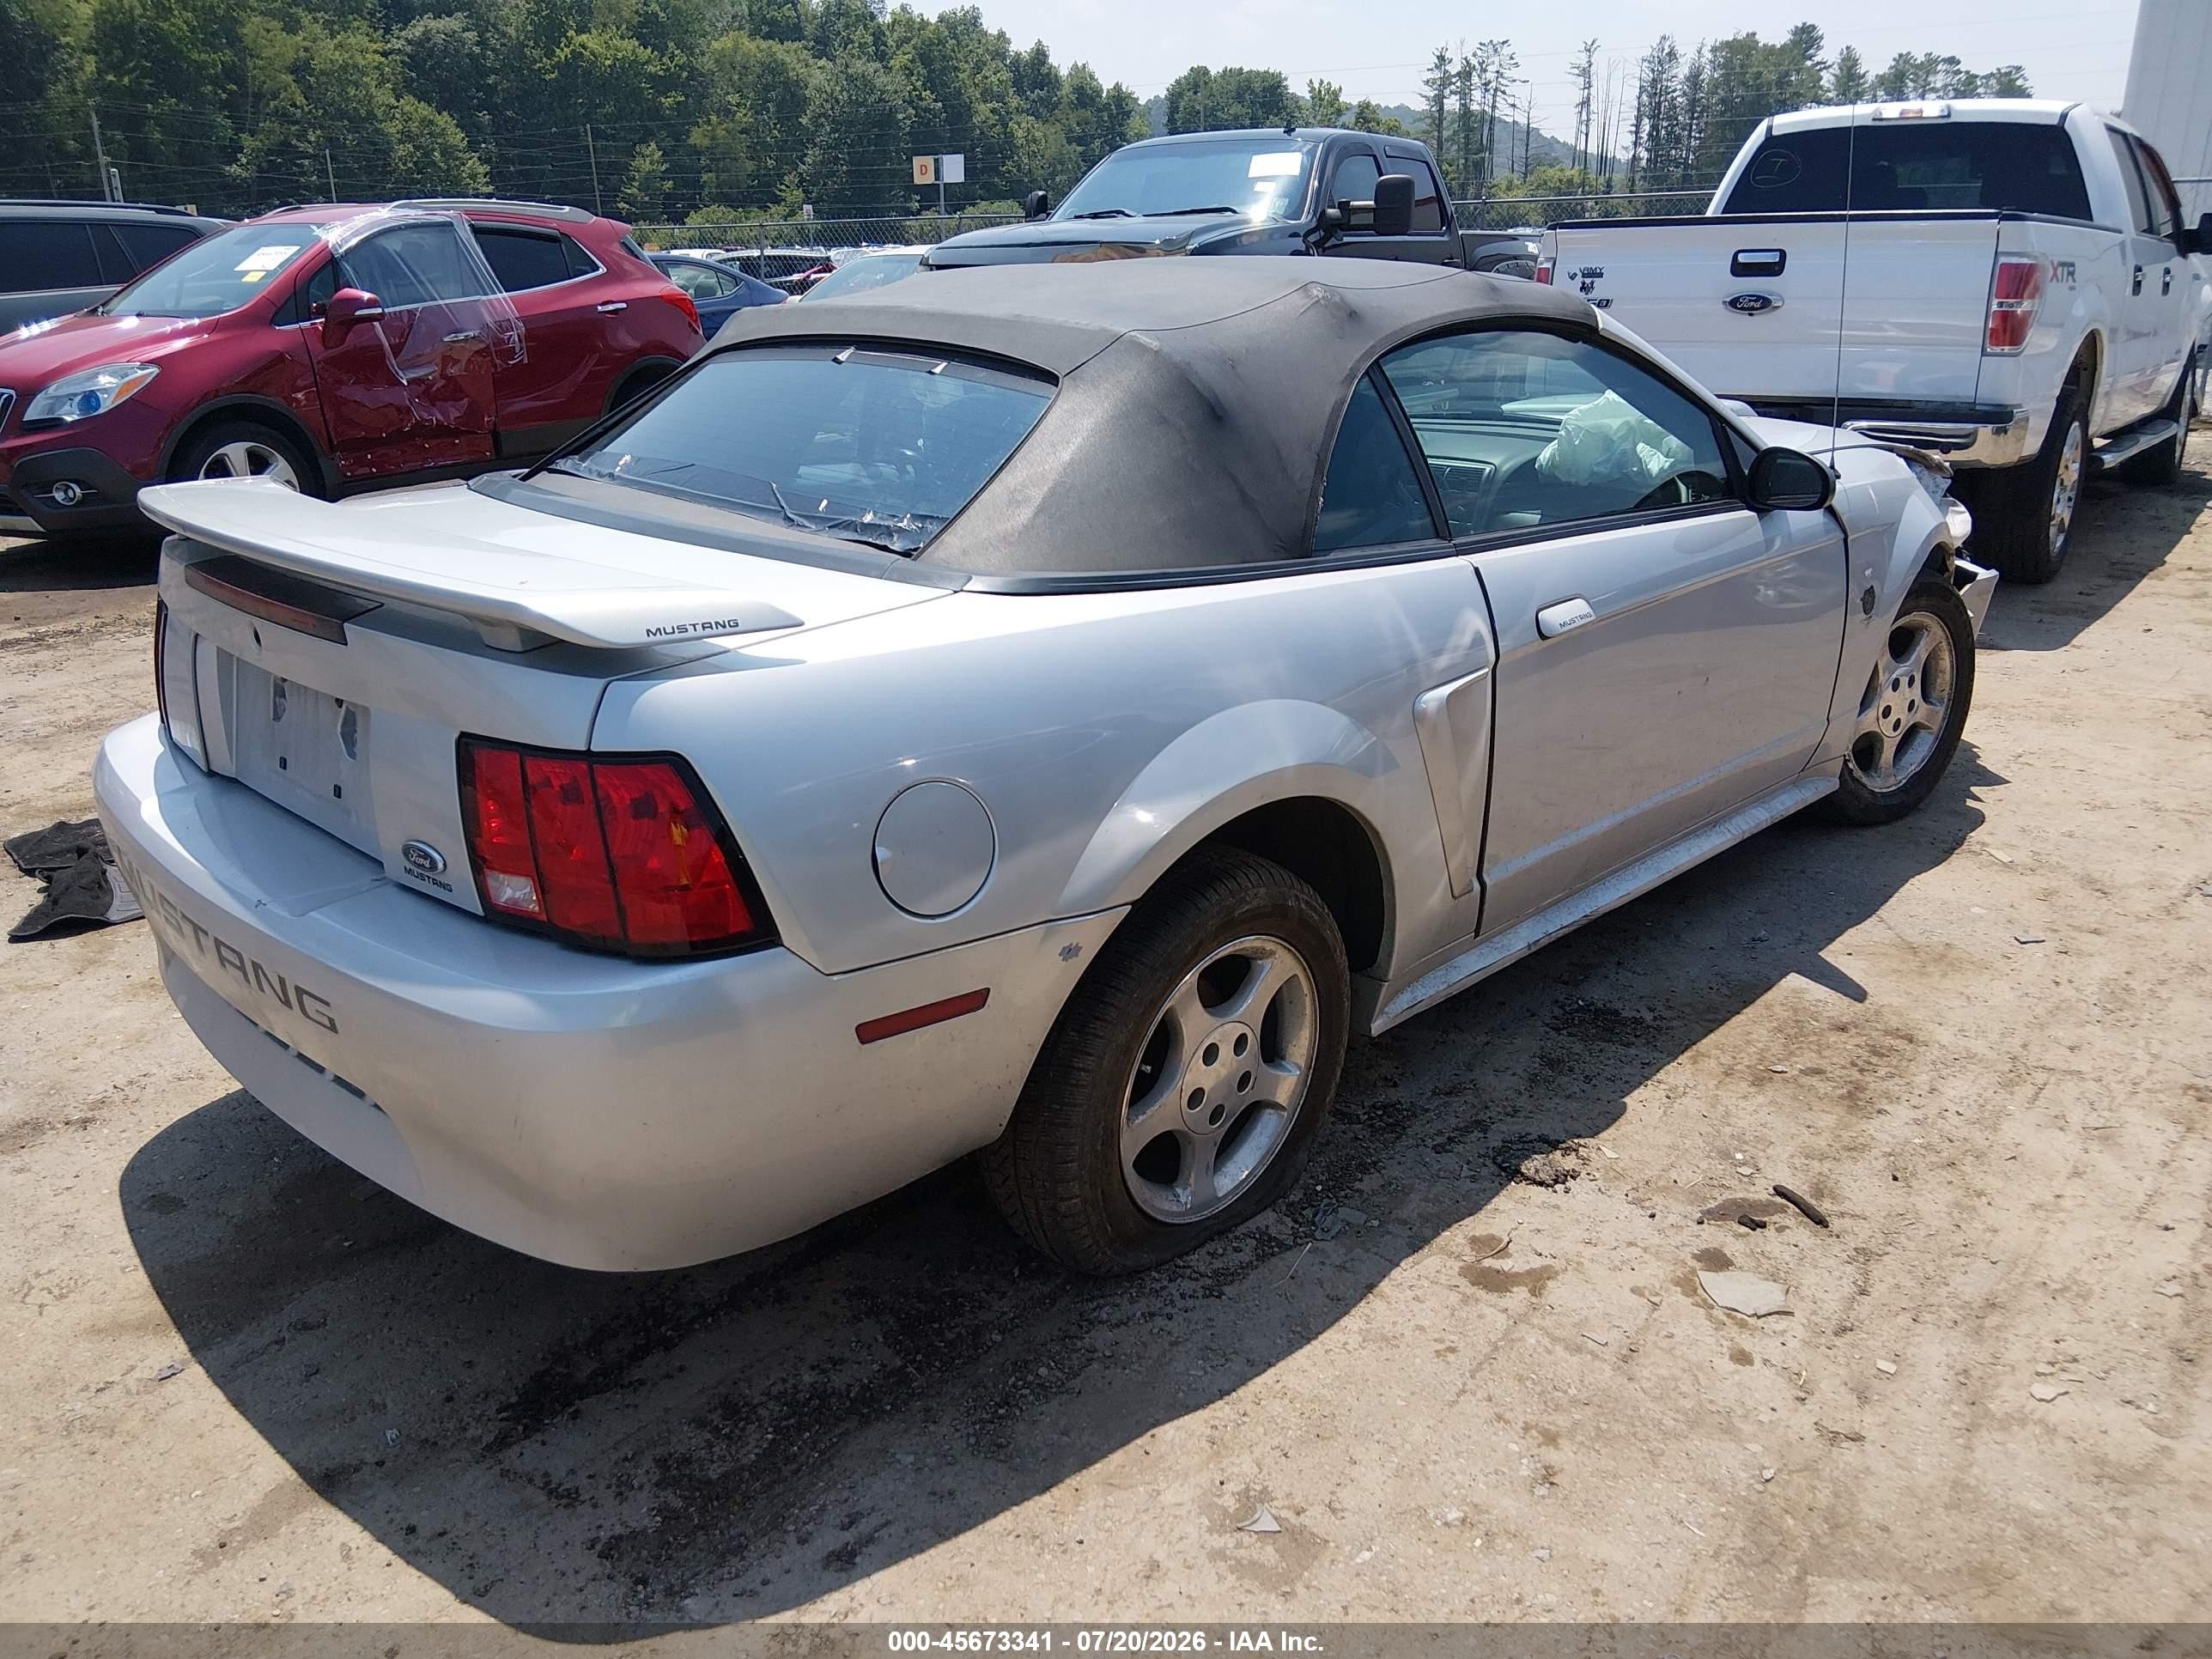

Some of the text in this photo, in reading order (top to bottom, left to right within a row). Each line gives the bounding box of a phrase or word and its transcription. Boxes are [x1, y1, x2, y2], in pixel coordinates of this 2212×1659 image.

[920, 164, 928, 176] D
[2049, 260, 2076, 283] XTR
[1736, 295, 1763, 308] Ford
[646, 618, 739, 638] MUSTANG
[1559, 611, 1593, 629] MUSTANG
[408, 848, 431, 868] Ford
[404, 865, 453, 893] MUSTANG
